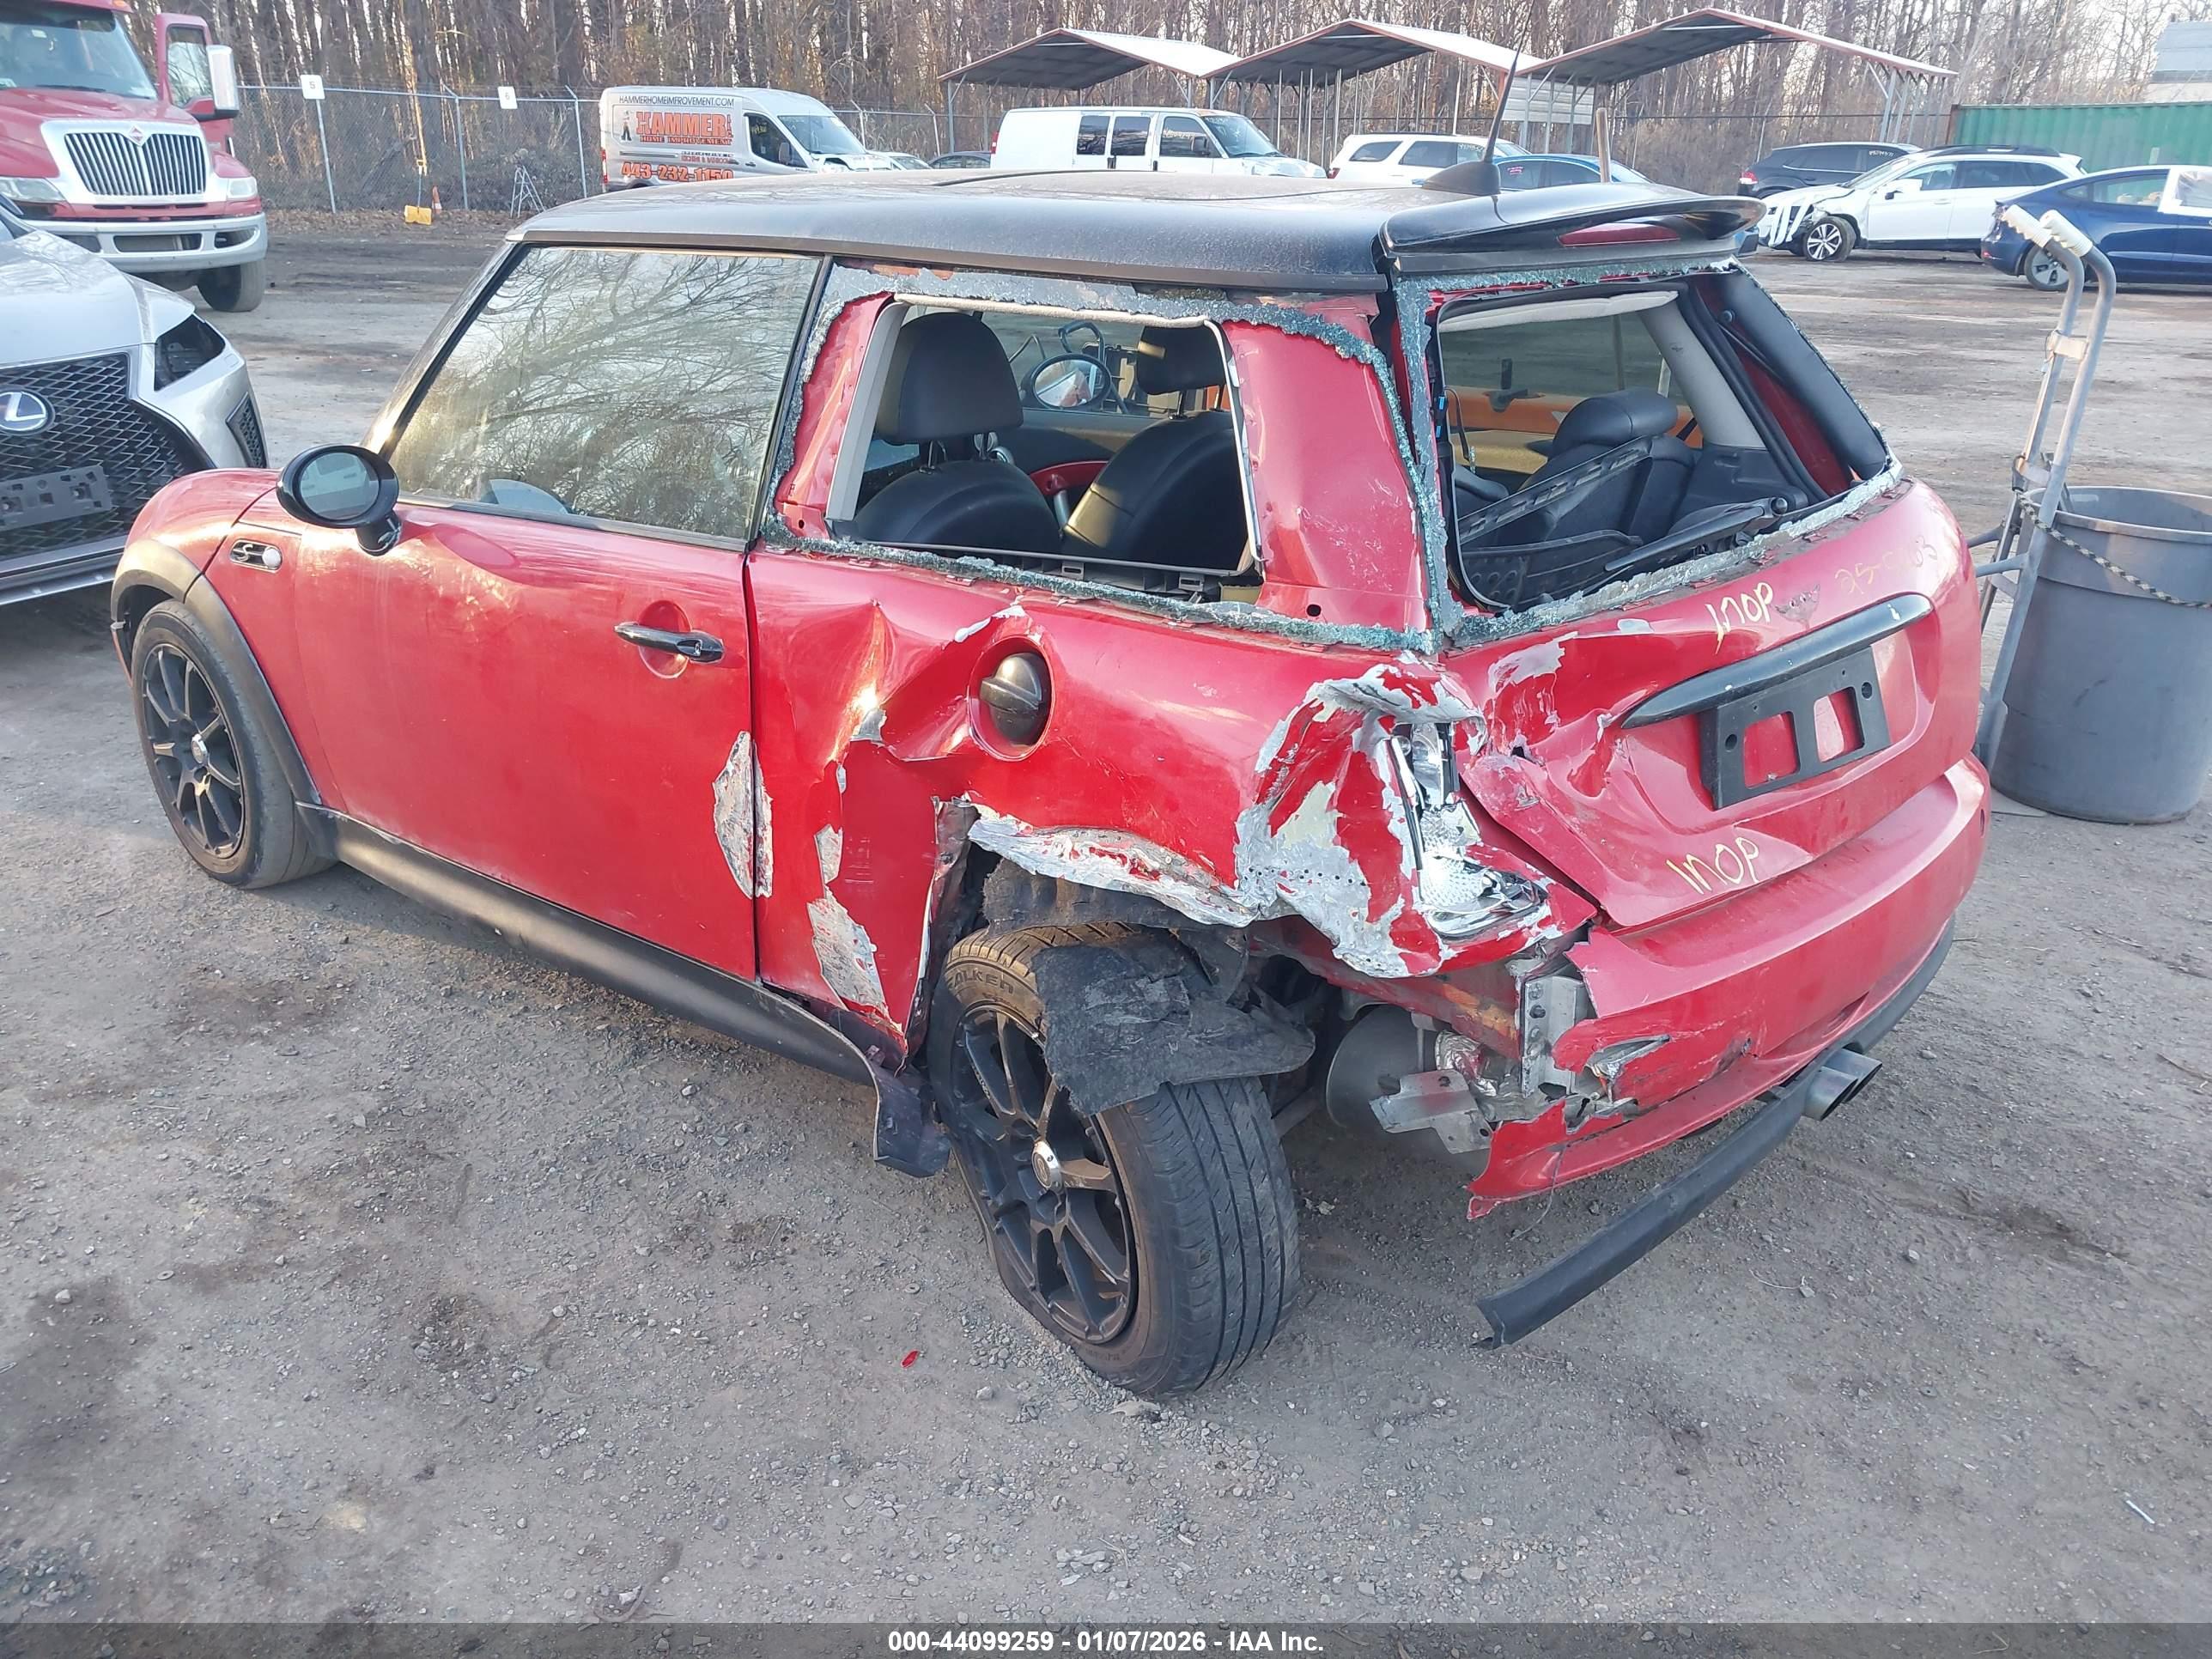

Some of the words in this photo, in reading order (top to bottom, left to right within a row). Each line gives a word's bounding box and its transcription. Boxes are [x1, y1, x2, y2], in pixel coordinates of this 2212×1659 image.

[308, 80, 316, 90] 5
[635, 111, 726, 138] HAMMER
[639, 135, 665, 143] HOME
[667, 136, 733, 146] IMPROVEMENT
[621, 161, 734, 182] 443-232-1150
